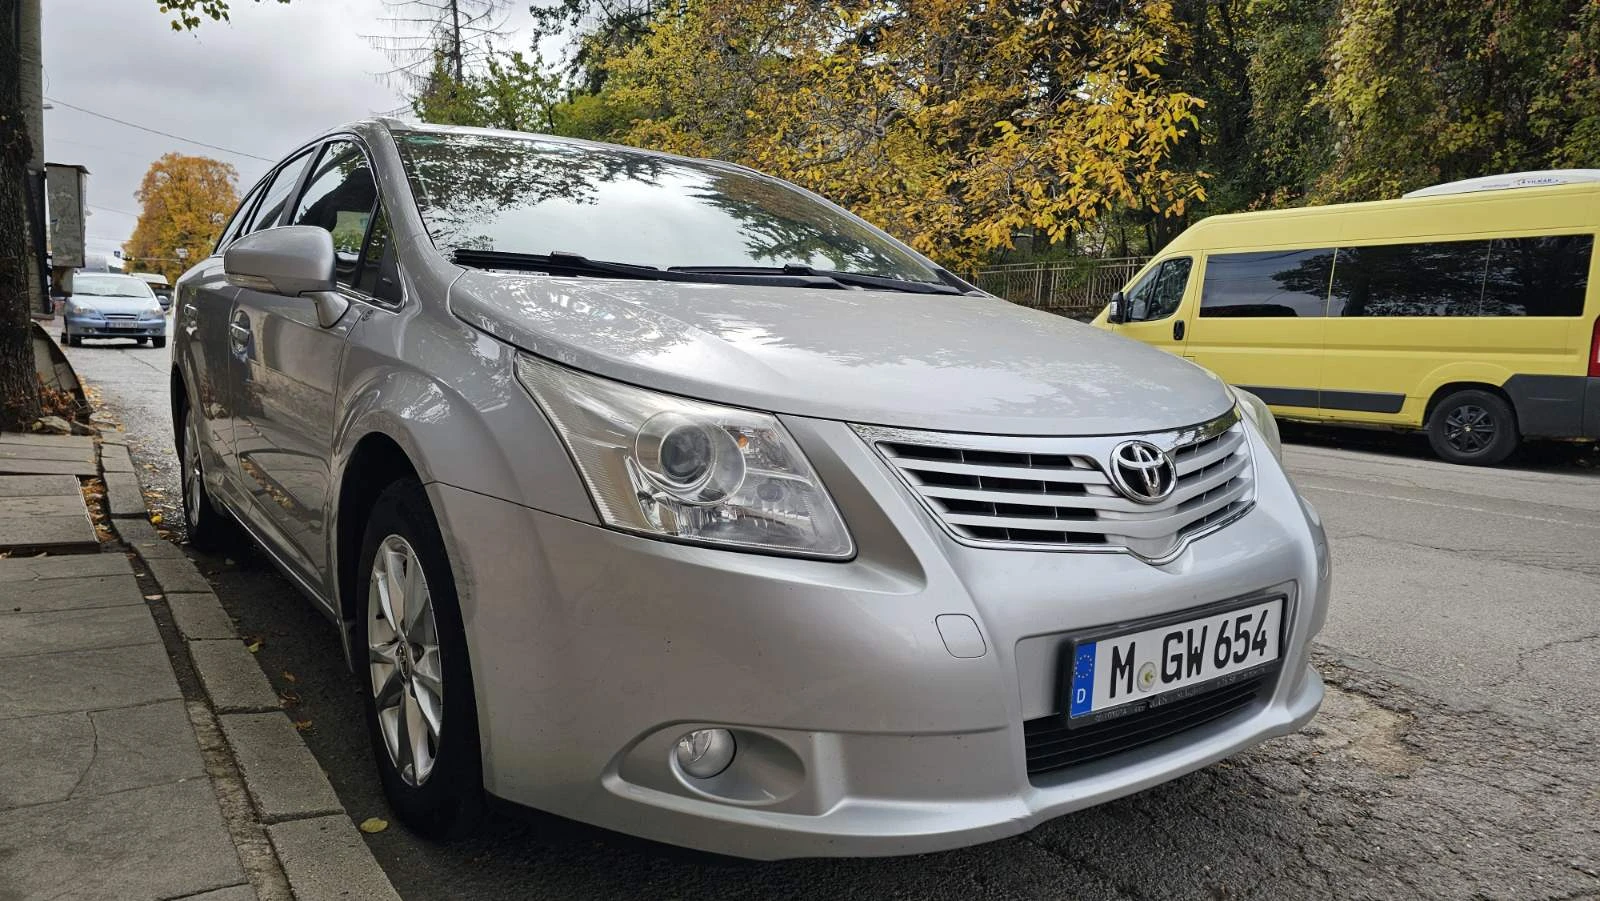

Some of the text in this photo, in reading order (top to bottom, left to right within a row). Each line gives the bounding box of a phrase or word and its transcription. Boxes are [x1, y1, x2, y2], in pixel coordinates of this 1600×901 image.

[1109, 609, 1269, 699] M GW 654
[1076, 687, 1086, 704] D
